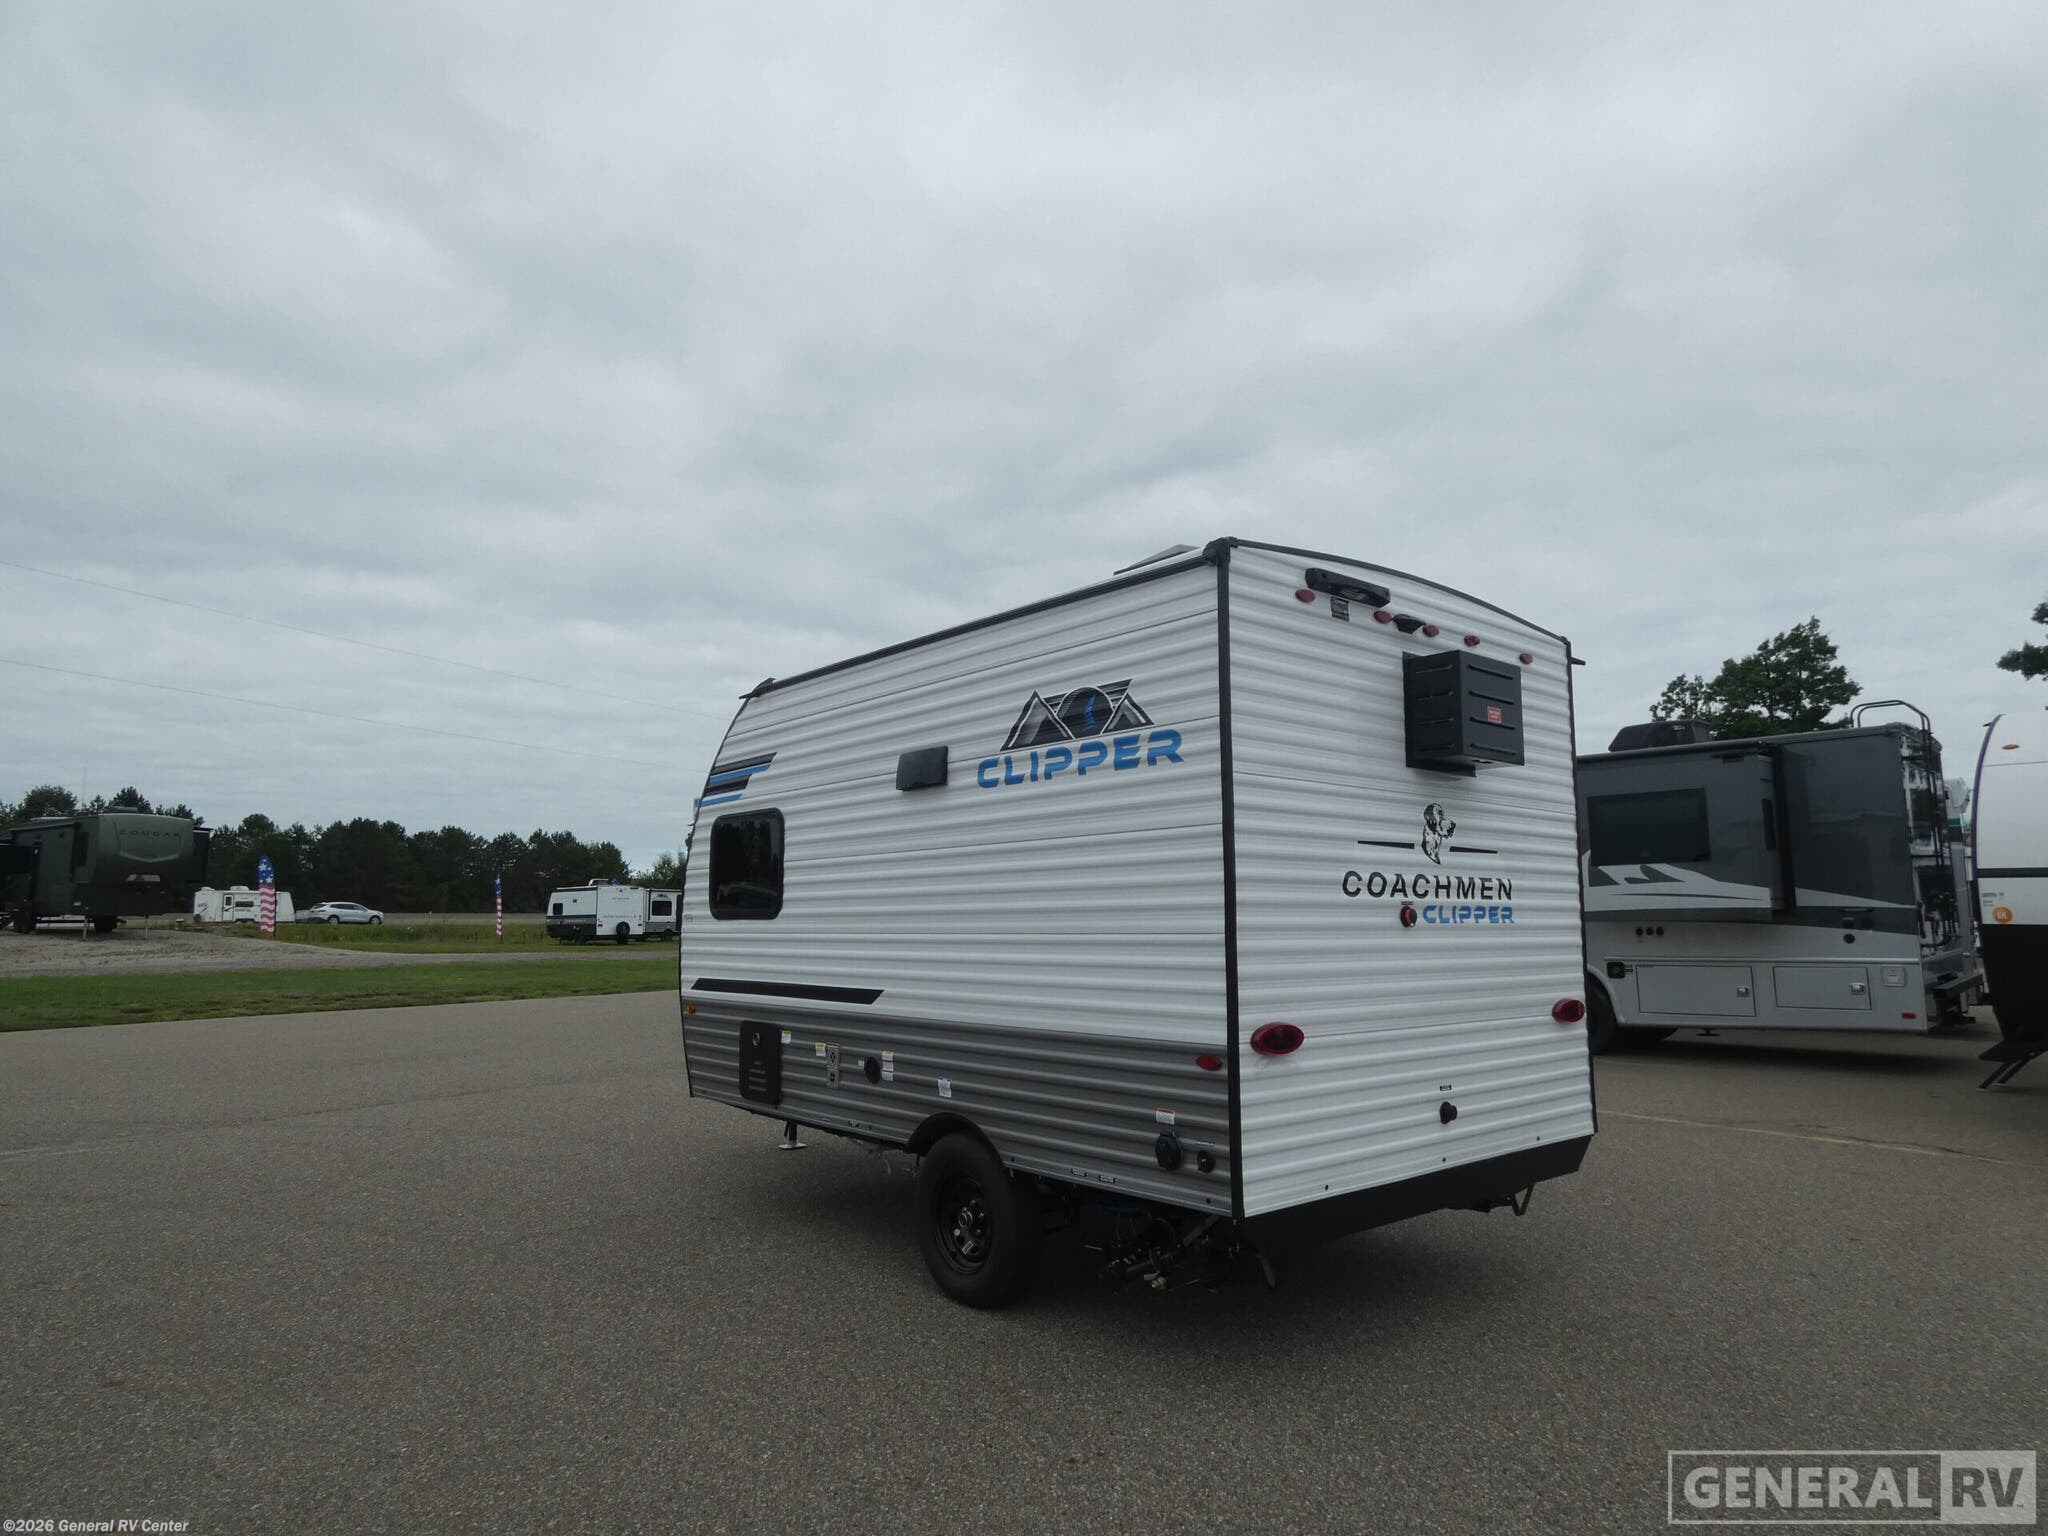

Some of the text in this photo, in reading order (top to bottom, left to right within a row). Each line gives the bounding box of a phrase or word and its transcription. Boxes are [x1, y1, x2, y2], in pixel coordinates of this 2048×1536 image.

[977, 728, 1184, 789] CLIPPER
[1342, 870, 1513, 901] COACHMEN
[1422, 904, 1515, 924] CLIPPER
